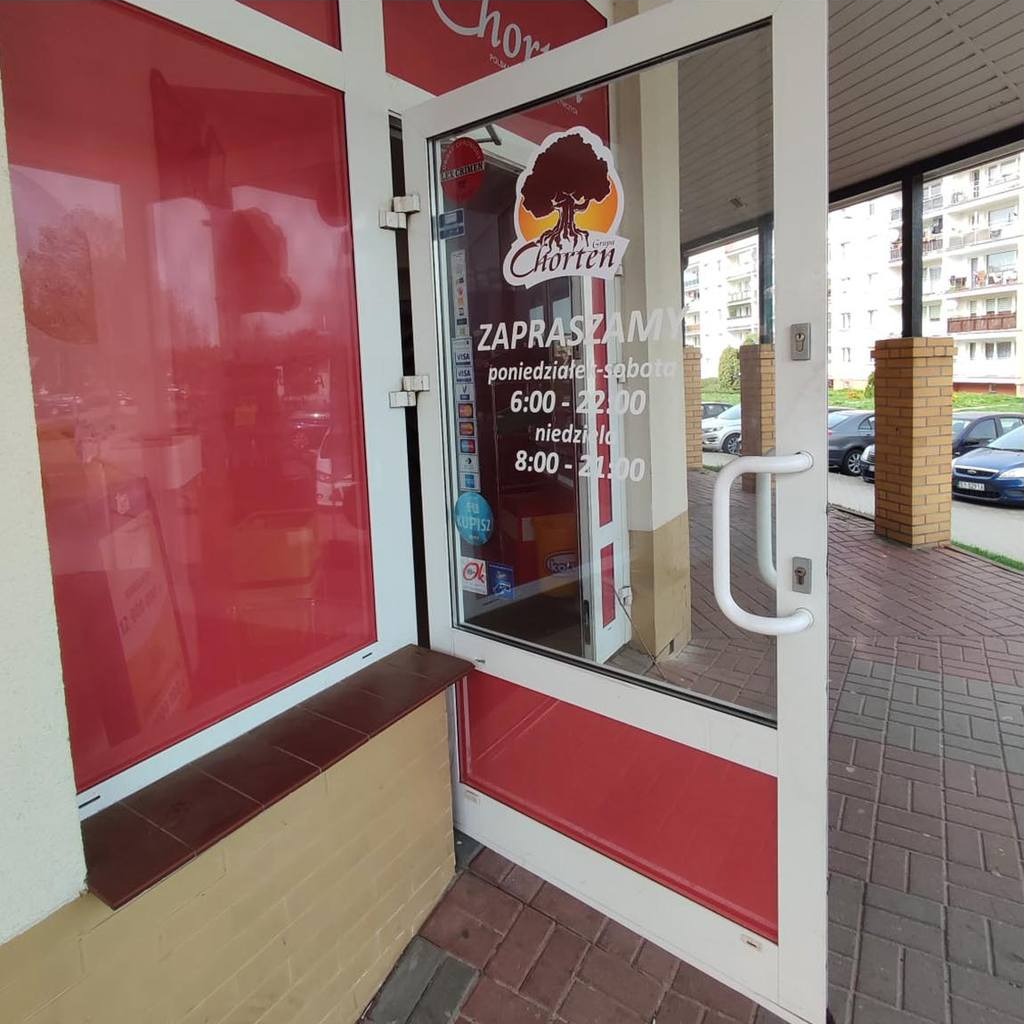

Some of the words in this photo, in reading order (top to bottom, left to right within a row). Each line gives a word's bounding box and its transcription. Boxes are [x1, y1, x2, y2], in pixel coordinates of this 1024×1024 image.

[593, 239, 615, 248] Grupa
[510, 240, 616, 278] Chorten
[477, 305, 690, 352] ZAPRASZAMY
[458, 369, 471, 377] VISA
[510, 390, 556, 414] 6:00
[576, 389, 646, 416] 22:00
[514, 450, 560, 474] 8:00
[578, 455, 646, 482] 21:00
